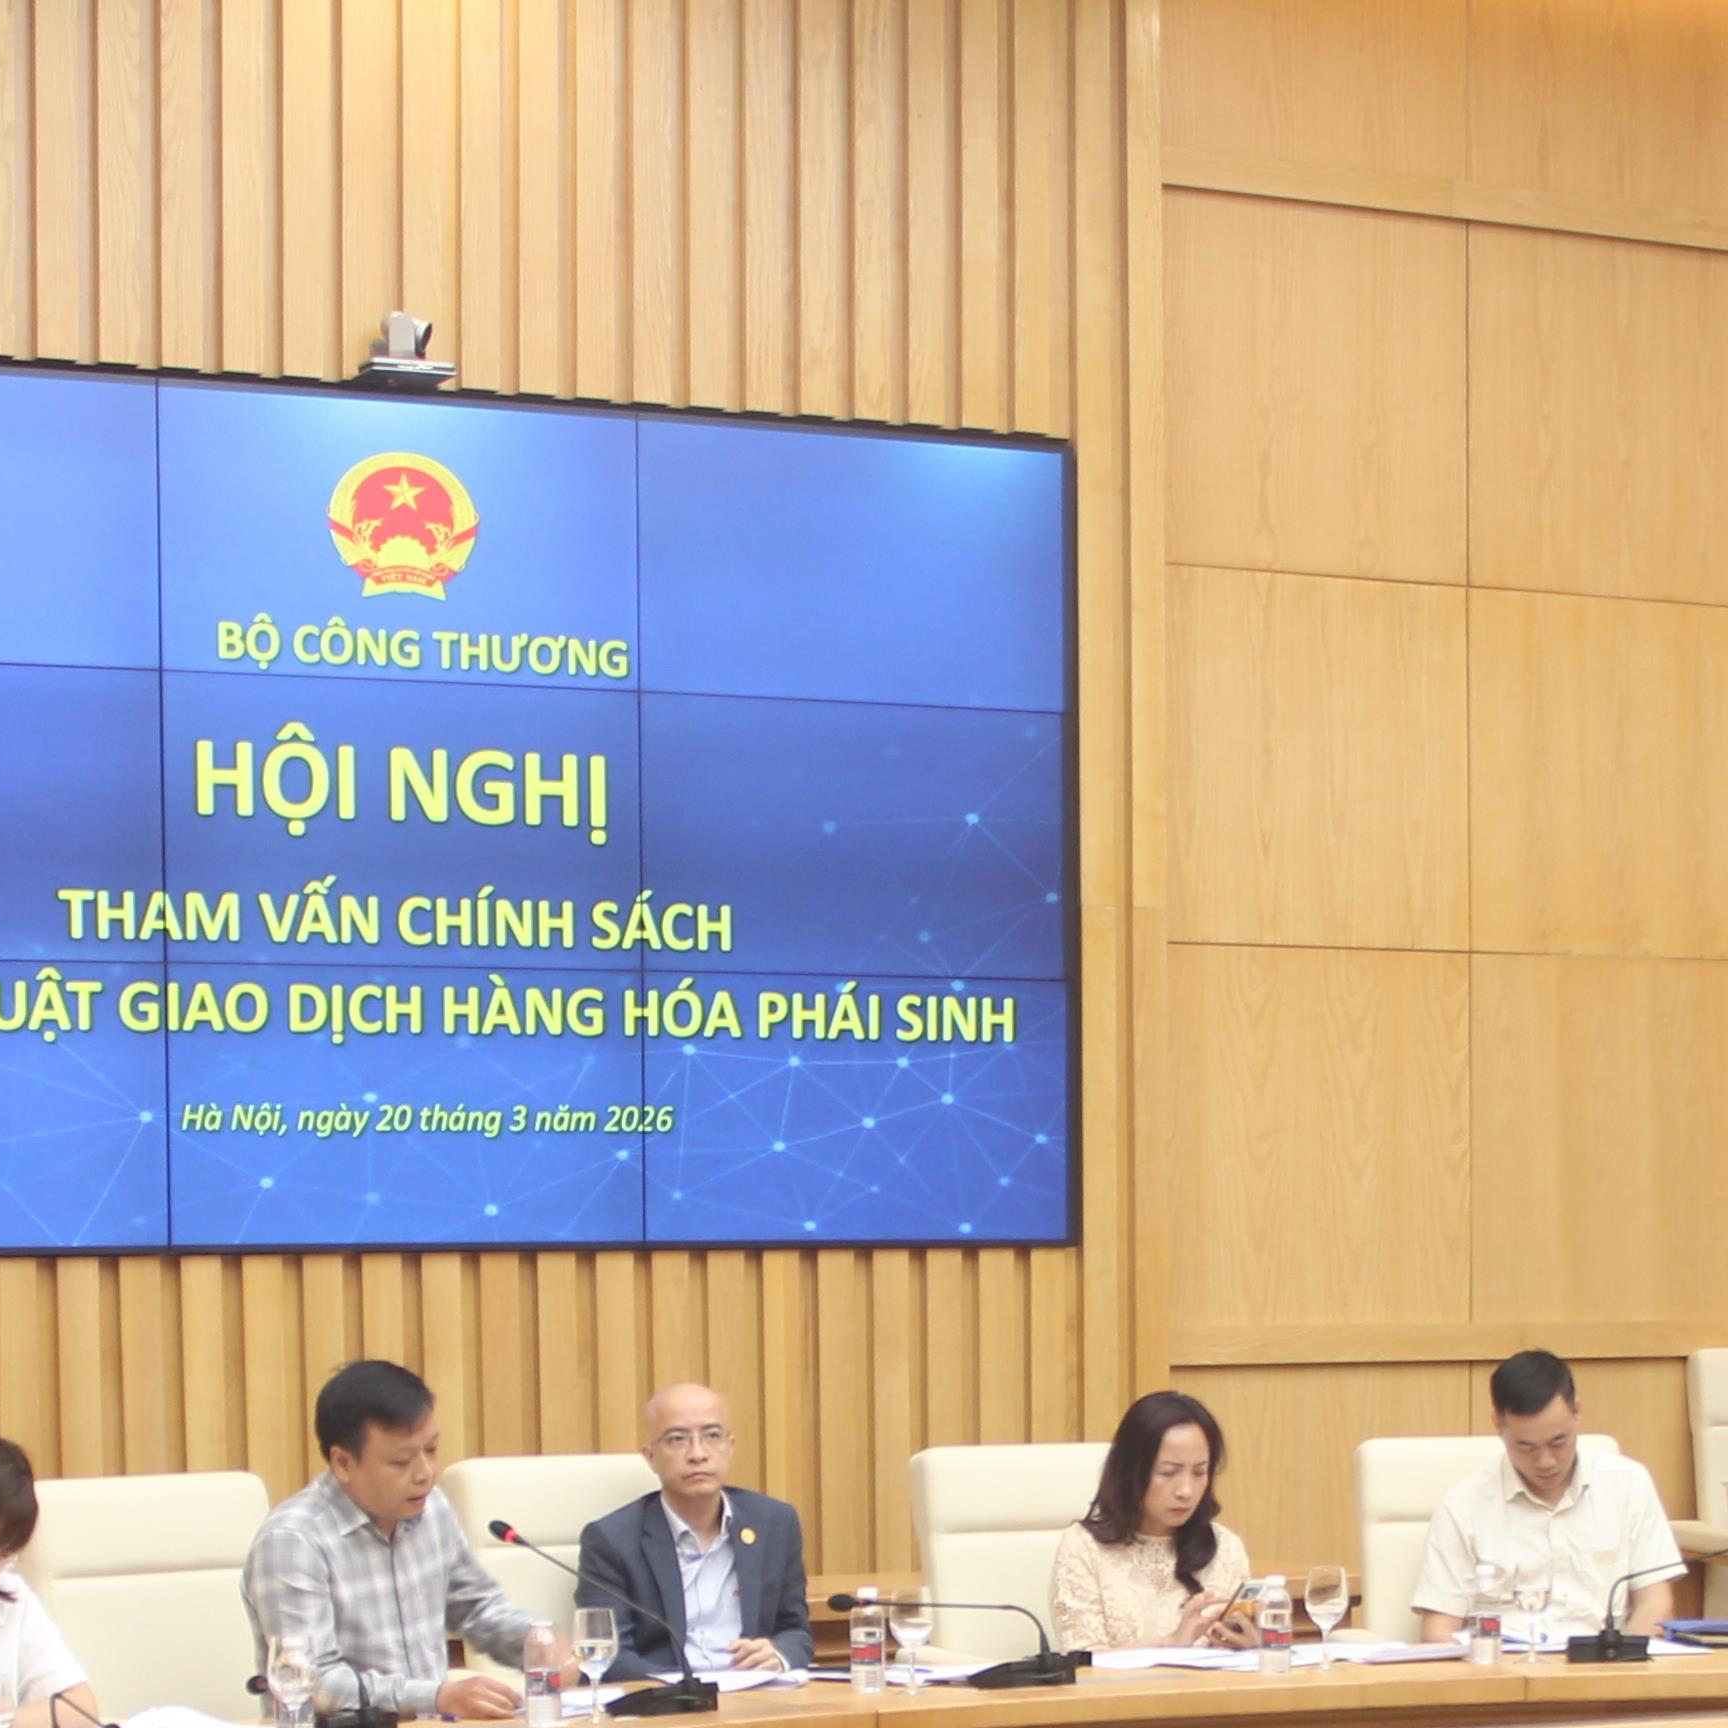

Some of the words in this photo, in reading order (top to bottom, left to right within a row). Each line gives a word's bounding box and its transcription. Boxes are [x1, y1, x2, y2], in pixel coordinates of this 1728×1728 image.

[217, 612, 282, 669] BỘ
[293, 616, 422, 668] CÔNG
[432, 631, 630, 678] THƯƠNG
[194, 720, 356, 837] HỘI
[388, 746, 608, 846] NGHỊ
[55, 888, 240, 941] THAM
[257, 874, 380, 944] VẤN
[396, 884, 575, 948] CHÍNH
[591, 889, 732, 952] SÁCH
[118, 981, 271, 1034] GIAO
[288, 983, 424, 1045] DỊCH
[443, 975, 606, 1038] HÀNG
[623, 978, 744, 1039] HÓA
[758, 980, 882, 1040] PHÁI
[896, 993, 1017, 1043] SINH
[181, 1103, 224, 1132] Hà
[230, 1103, 288, 1135] Nội,
[297, 1104, 369, 1138] ngày
[375, 1104, 412, 1133] 20
[419, 1104, 504, 1139] tháng
[509, 1104, 529, 1133] 3
[534, 1104, 598, 1133] năm
[603, 1104, 676, 1134] 2026
